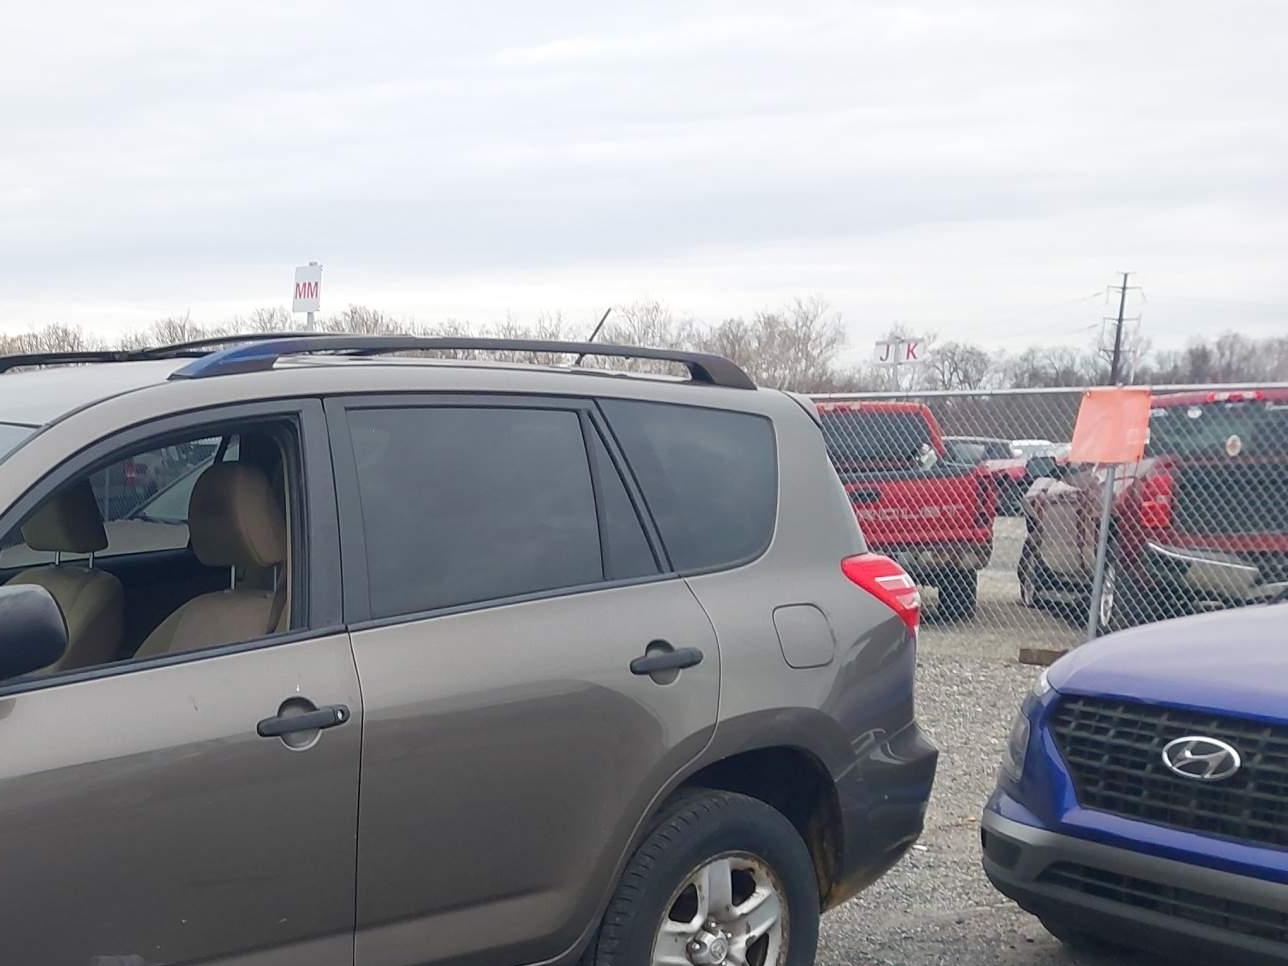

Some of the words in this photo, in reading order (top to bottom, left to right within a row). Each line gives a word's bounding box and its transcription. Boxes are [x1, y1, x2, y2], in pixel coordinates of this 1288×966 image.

[295, 281, 319, 299] MM
[879, 343, 890, 362] J
[906, 342, 918, 360] K
[857, 504, 964, 521] ROLET
